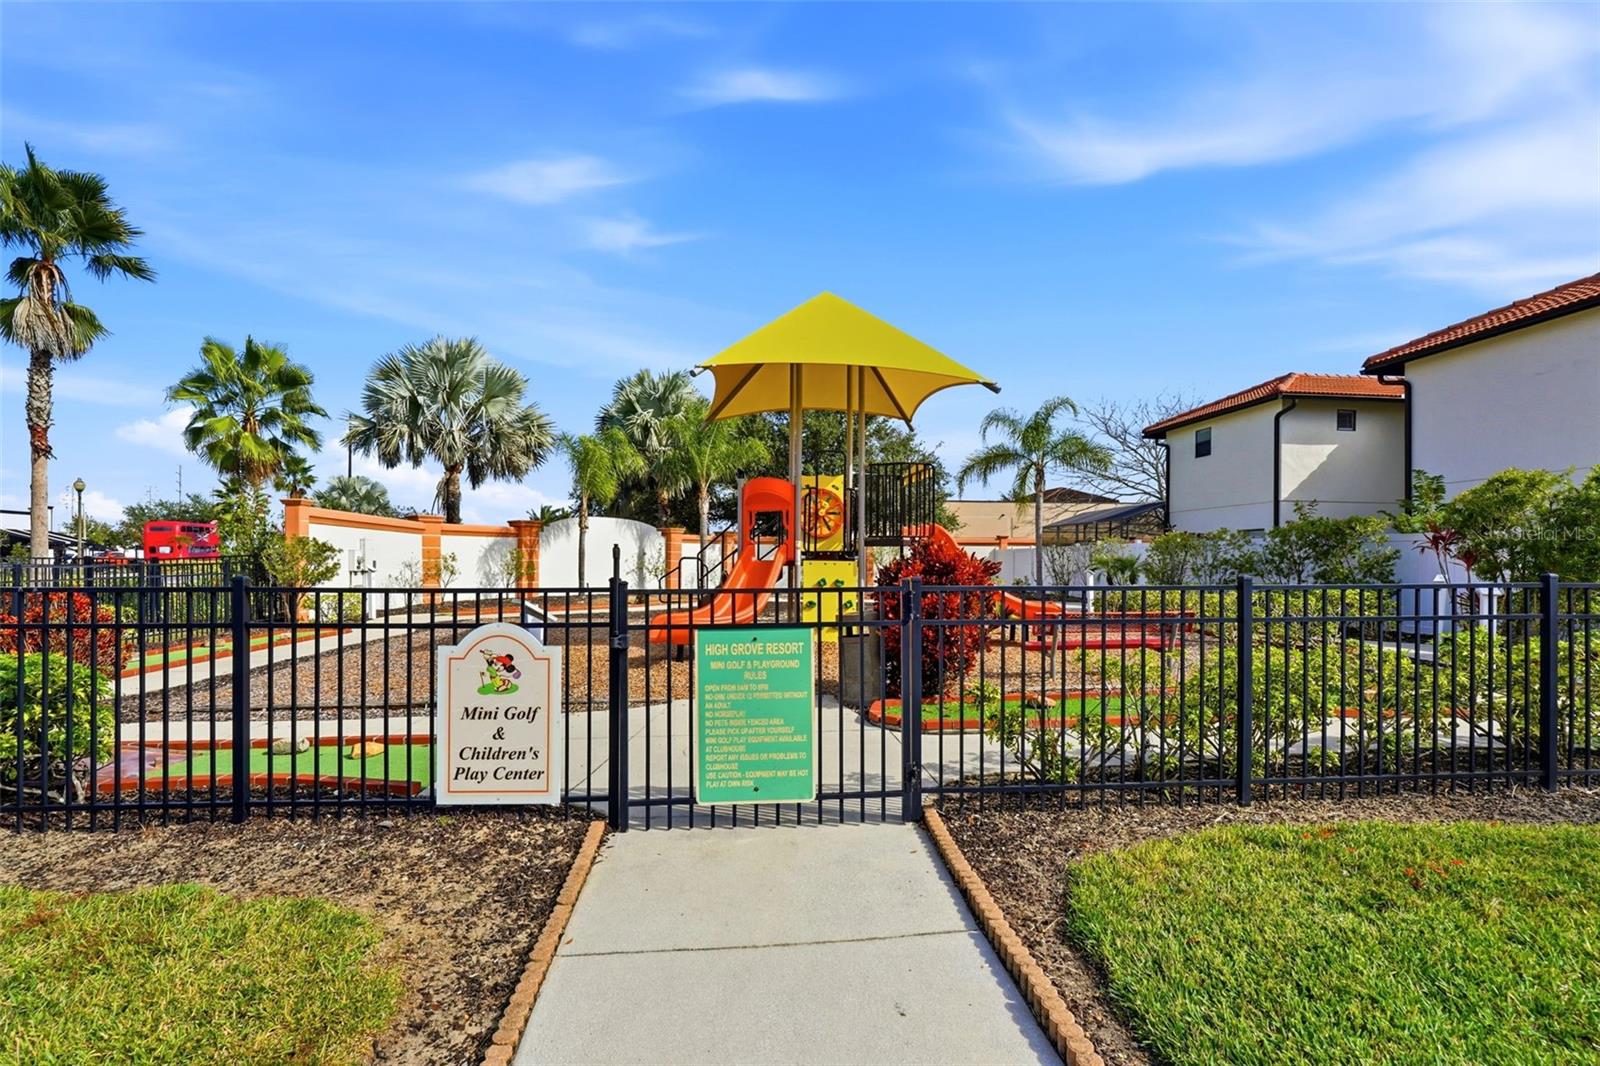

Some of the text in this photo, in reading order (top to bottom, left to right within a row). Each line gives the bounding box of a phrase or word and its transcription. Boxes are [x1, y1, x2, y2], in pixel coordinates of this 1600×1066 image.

[705, 643, 804, 656] HIGH GROVE RESORT
[726, 661, 746, 670] GOLF
[752, 660, 800, 669] PLAYGROUND
[460, 706, 541, 724] Mini Golf
[492, 726, 506, 741] &
[458, 746, 540, 761] Children's
[453, 766, 545, 784] Play Center
